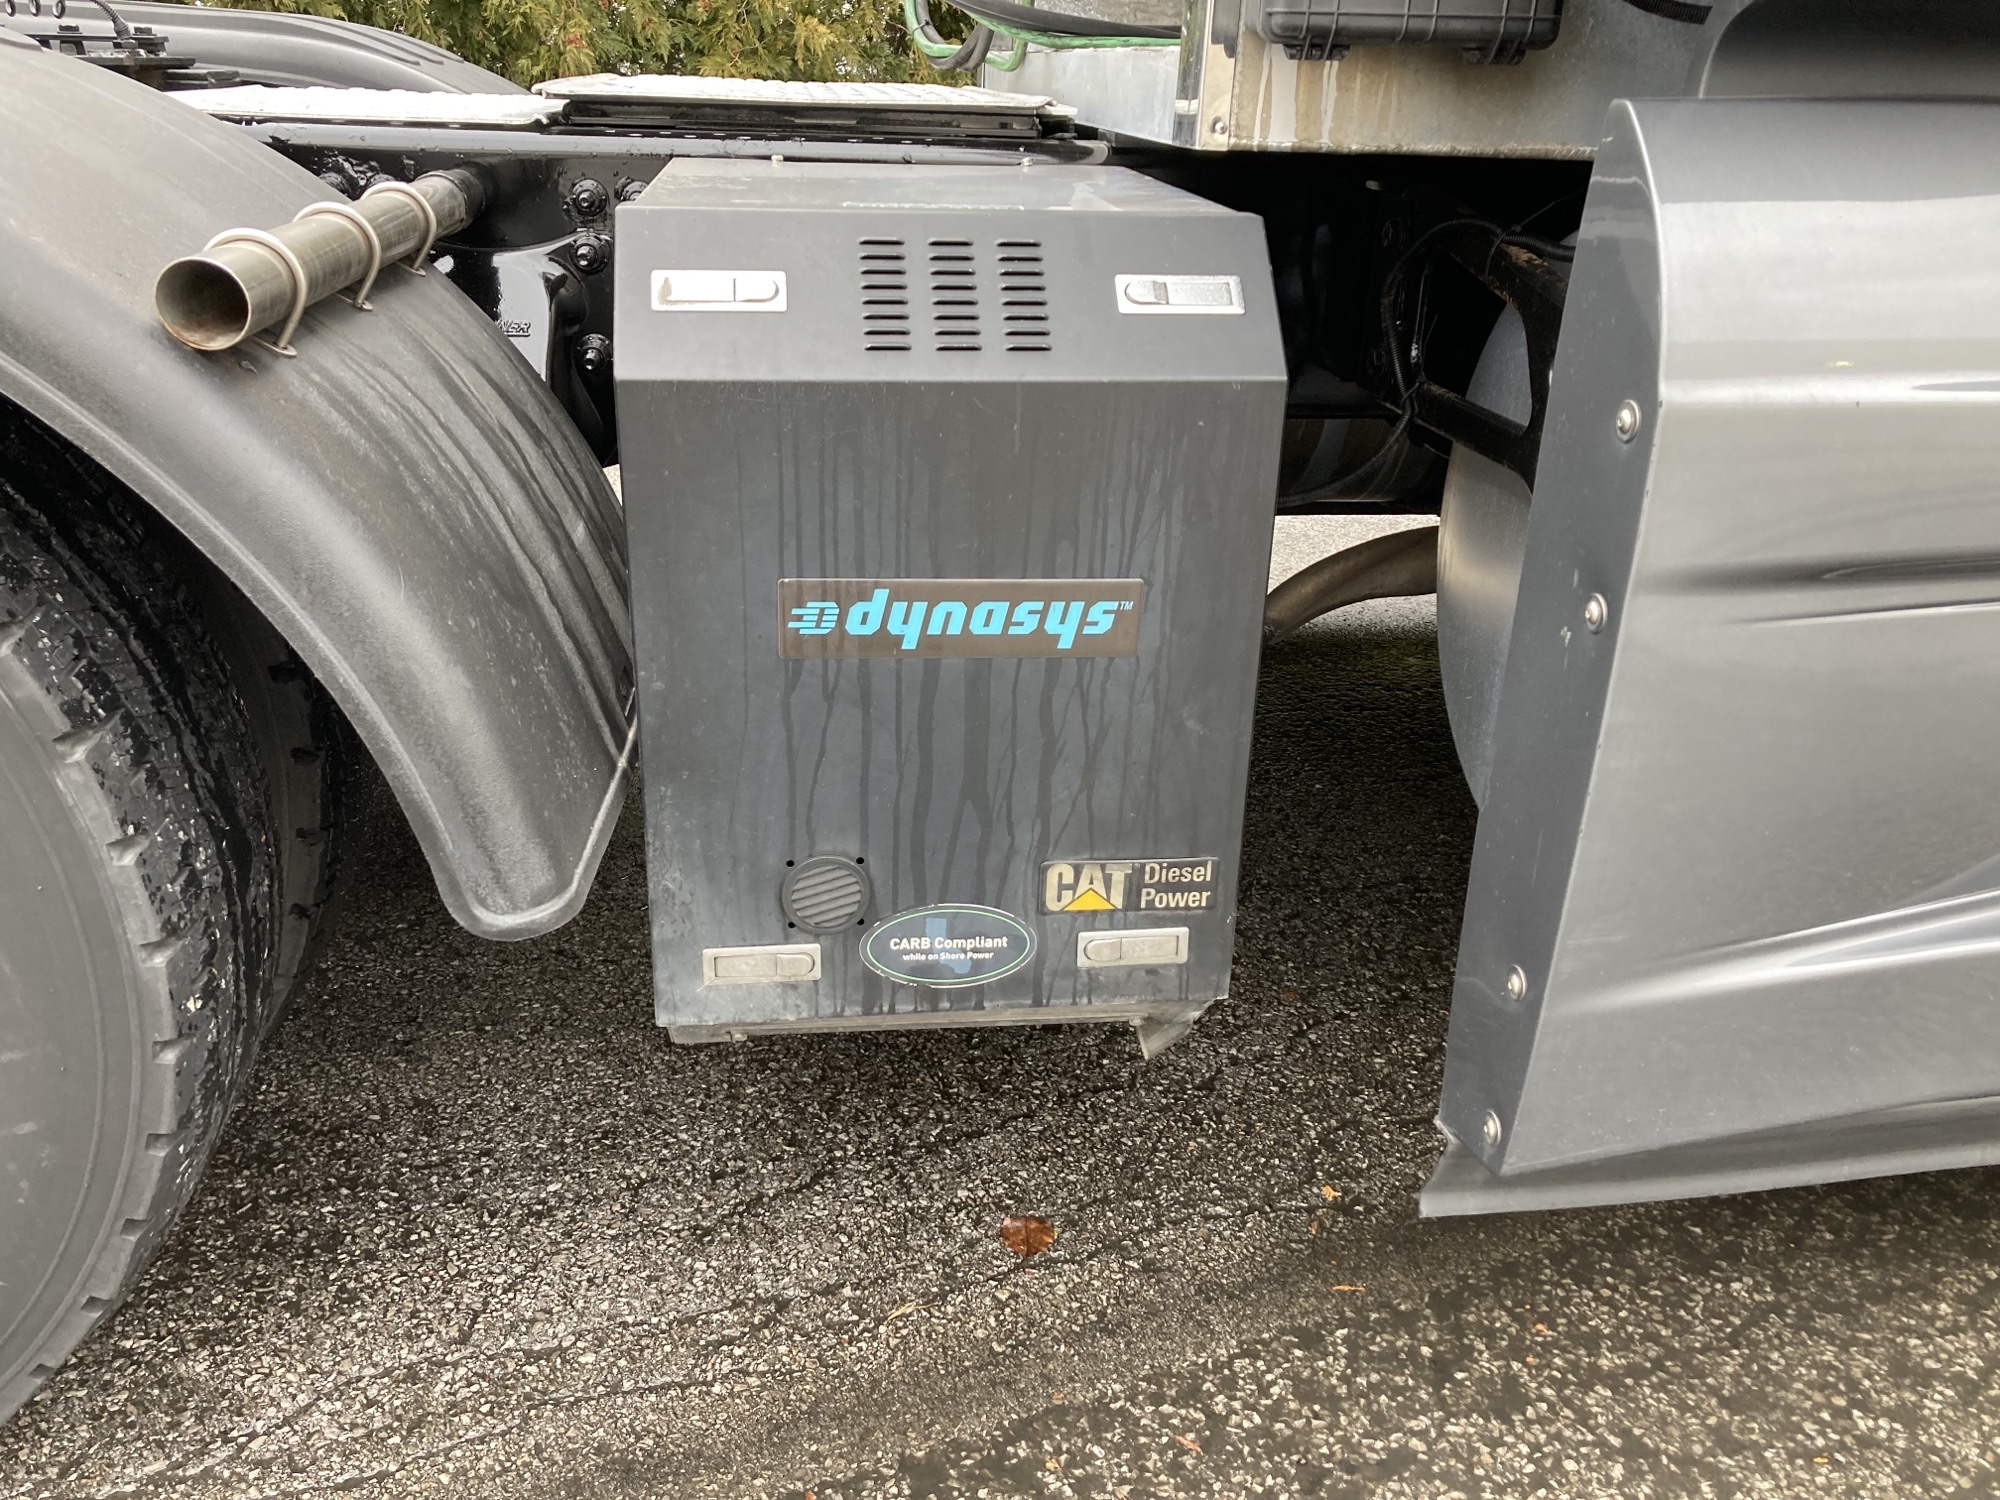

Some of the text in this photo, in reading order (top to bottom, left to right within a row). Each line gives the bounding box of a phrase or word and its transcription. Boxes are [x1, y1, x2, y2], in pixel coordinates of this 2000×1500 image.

[845, 588, 1119, 650] dynasys
[1144, 860, 1212, 884] Diesel
[1045, 862, 1133, 912] CAT
[1140, 887, 1211, 909] Power
[889, 936, 1008, 950] CARB Compliant
[902, 953, 926, 961] while
[940, 952, 965, 960] Shore
[967, 951, 994, 959] Power
